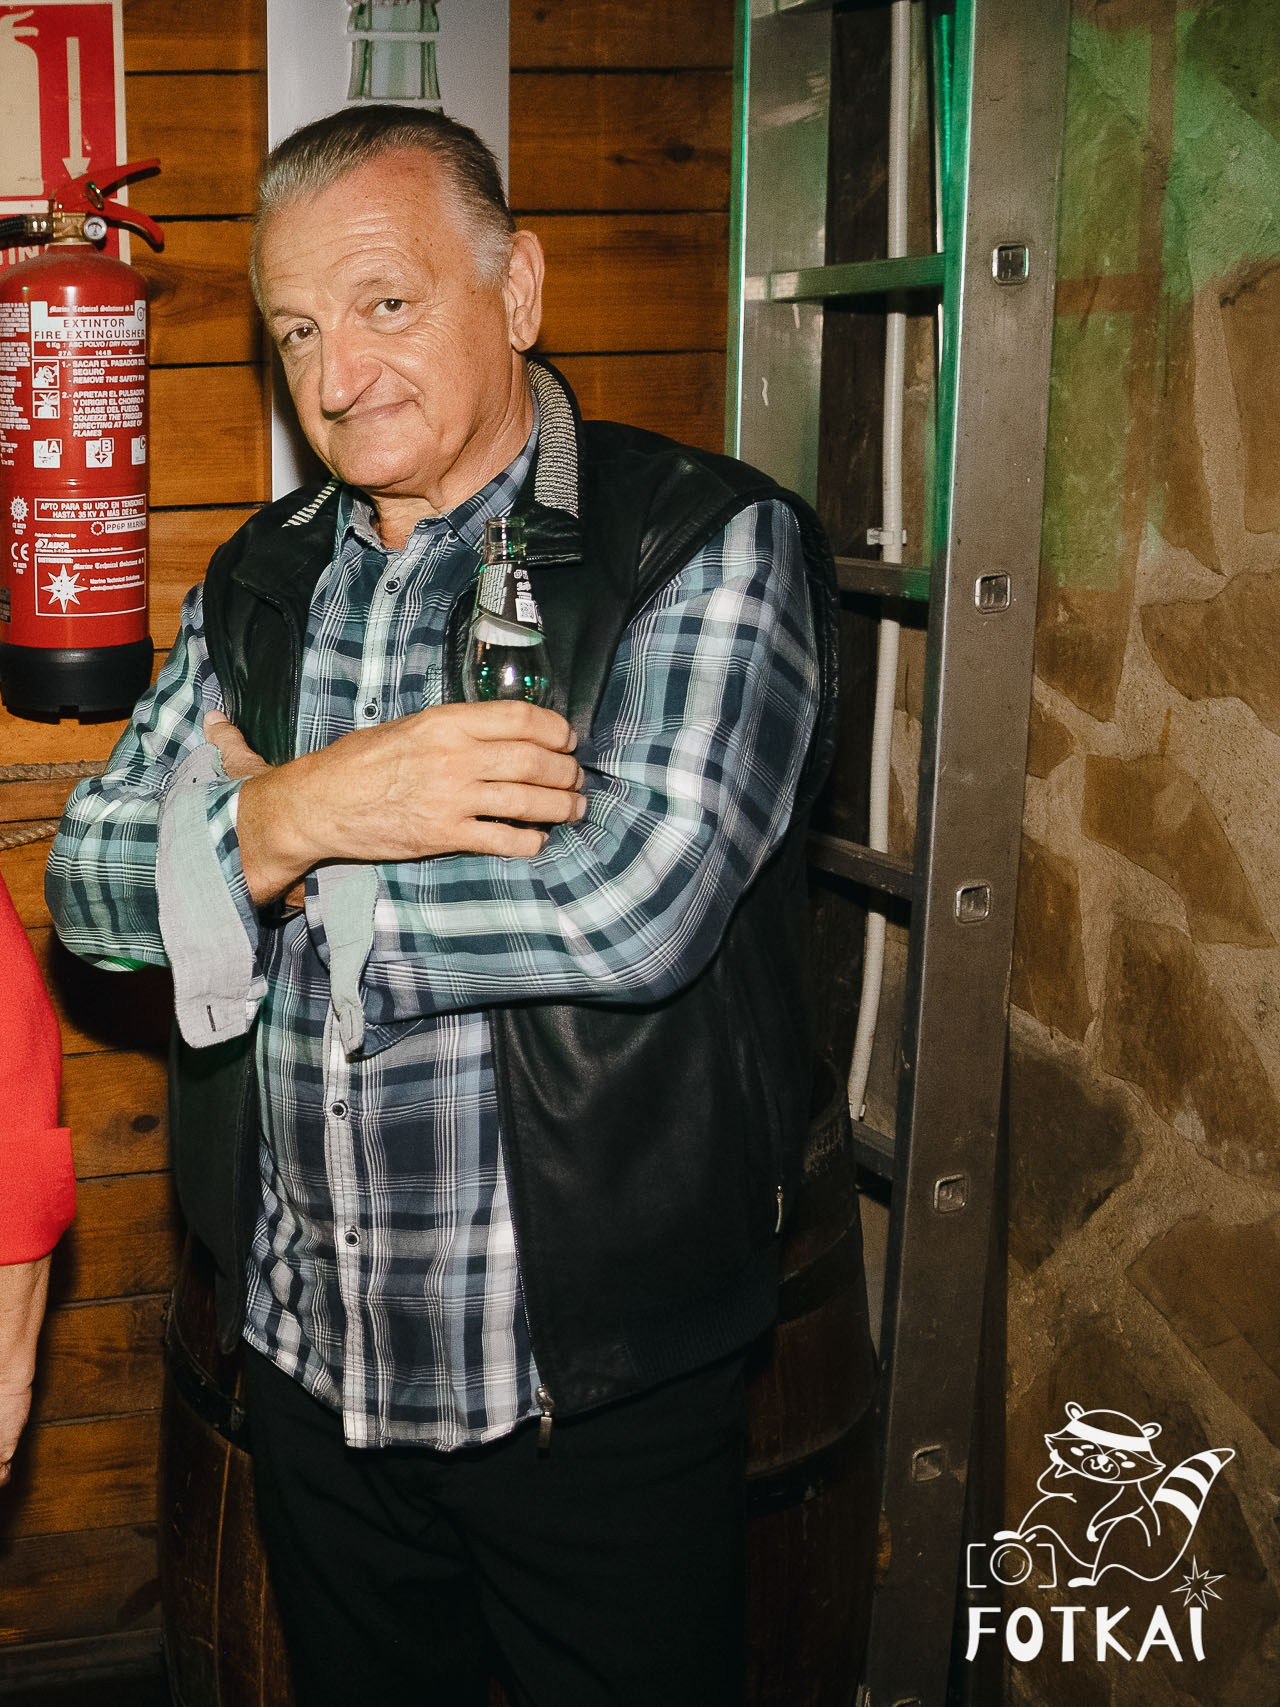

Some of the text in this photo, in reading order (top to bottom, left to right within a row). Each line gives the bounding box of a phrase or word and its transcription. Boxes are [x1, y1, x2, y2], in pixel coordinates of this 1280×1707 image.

[63, 318, 125, 328] EXTINTOR
[34, 329, 145, 340] FIRE EXTINGUISHER
[72, 368, 105, 376] SEGURO
[73, 376, 104, 384] REMOVE
[73, 414, 107, 422] SQUEEZE
[73, 421, 113, 429] DIRECTING
[122, 420, 136, 428] BASE
[73, 429, 102, 437] FLAMES
[48, 440, 59, 453] A
[101, 439, 111, 452] B
[40, 502, 58, 510] APTO
[61, 502, 80, 510] PARA
[82, 502, 92, 510] SU
[53, 511, 75, 519] HASTA
[121, 508, 129, 516] DE
[11, 542, 29, 562] CE
